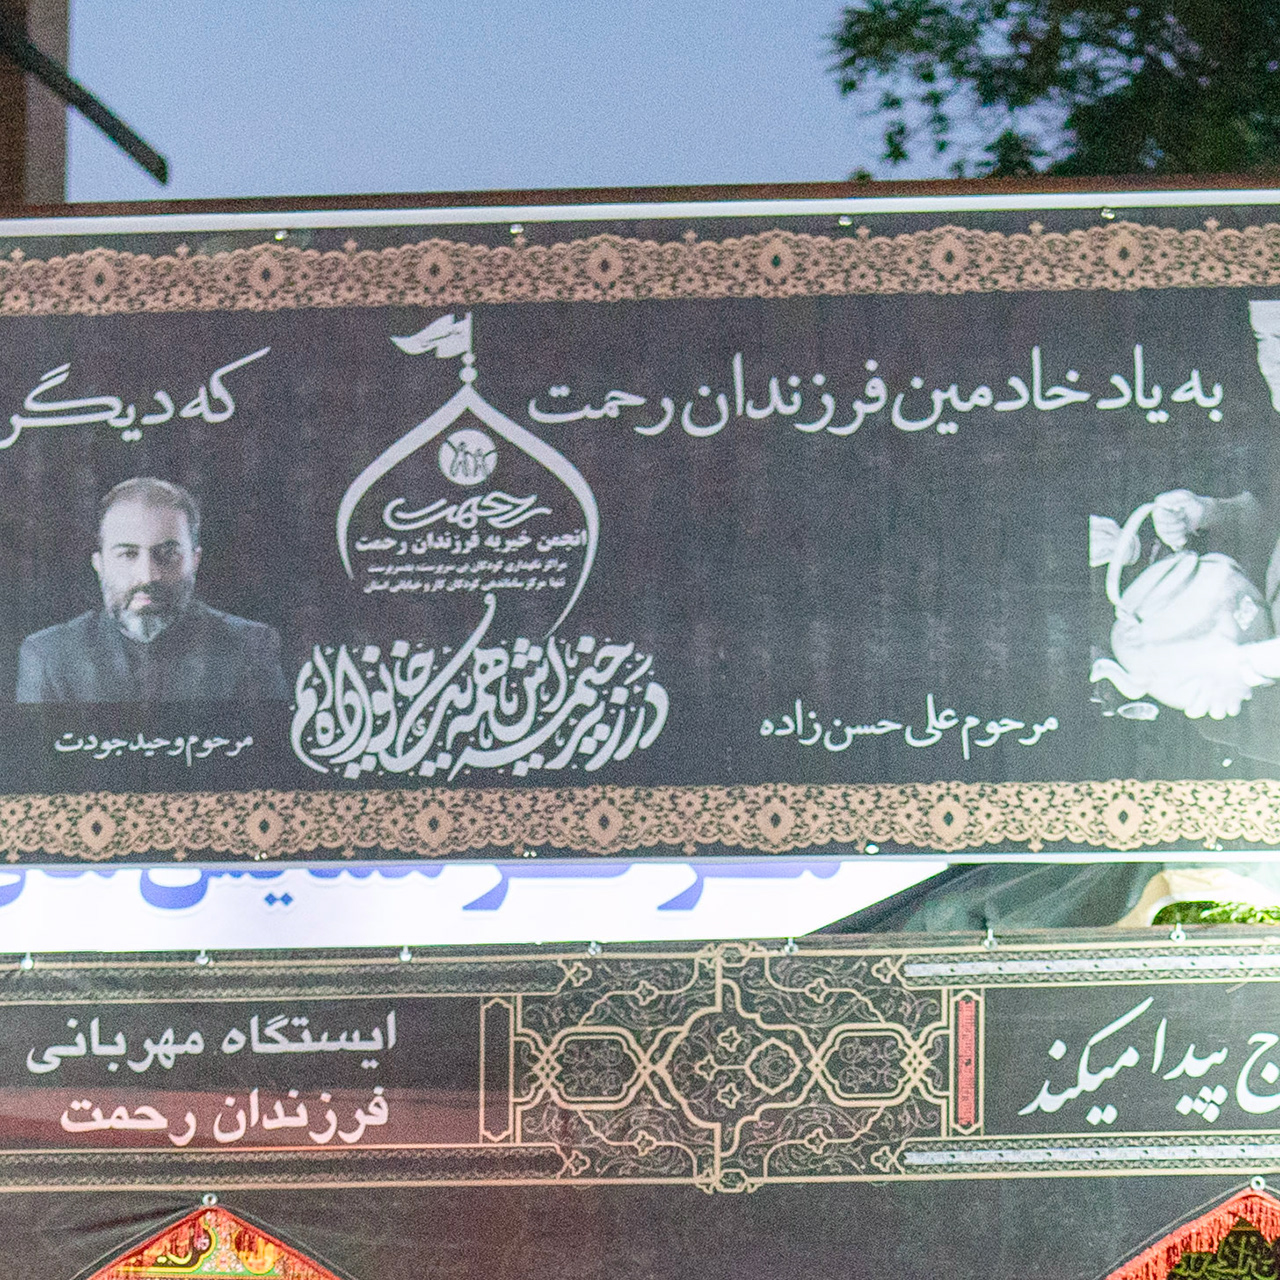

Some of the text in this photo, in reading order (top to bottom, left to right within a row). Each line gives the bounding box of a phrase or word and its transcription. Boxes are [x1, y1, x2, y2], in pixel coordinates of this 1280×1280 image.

[180, 346, 271, 424] که
[528, 344, 1224, 437] به یاد خادمین فرزندان رحمت
[355, 528, 587, 556] انجمن خیریه فرزندان رحمت
[54, 733, 254, 767] مرحوم وحید جودت
[760, 693, 1058, 760] مرحوم علی حسن زاده
[26, 1010, 398, 1074] ایستگاه مهربانی
[1151, 1018, 1229, 1123] پیدا
[60, 1086, 389, 1146] فرزندان رحمت
